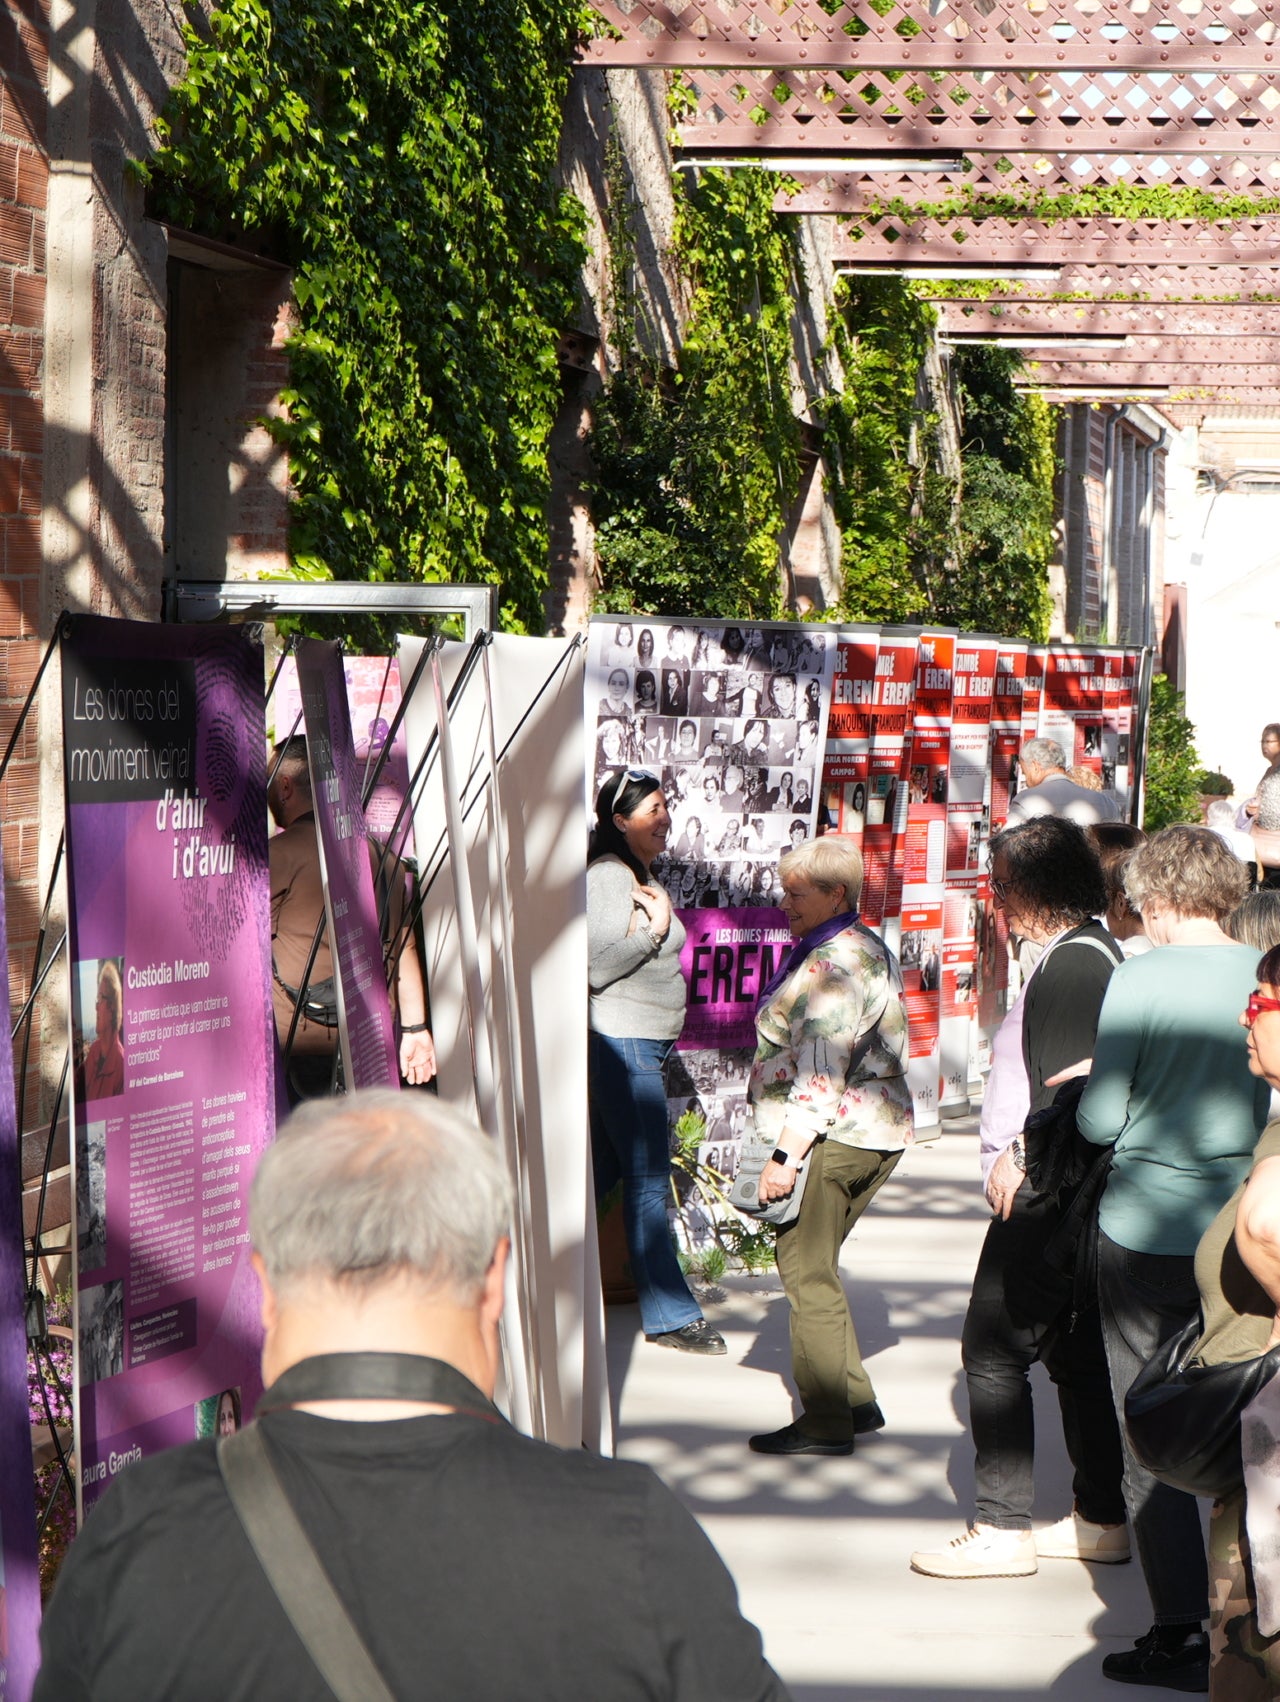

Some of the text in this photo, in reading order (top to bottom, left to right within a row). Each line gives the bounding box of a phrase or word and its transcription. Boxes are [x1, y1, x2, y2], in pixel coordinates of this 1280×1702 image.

[73, 677, 180, 721] Les dones del
[70, 736, 191, 782] moviment veïnal
[825, 754, 841, 764] ARÍA
[830, 768, 855, 776] CAMPOS
[380, 824, 402, 833] Doa
[172, 837, 179, 879] i
[715, 929, 732, 944] LES
[732, 928, 762, 943] DONES
[127, 960, 210, 990] Custòdia Moreno
[139, 1008, 161, 1026] primera
[160, 1004, 179, 1019] victòria
[179, 1004, 191, 1019] que
[190, 1001, 203, 1013] vam
[127, 1033, 138, 1046] ser
[162, 1027, 173, 1043] por
[175, 1022, 190, 1038] sortir
[189, 1020, 195, 1034] al
[195, 1020, 211, 1034] carrer
[211, 1018, 221, 1034] per
[221, 1015, 231, 1028] uns
[234, 1144, 251, 1156] seus
[235, 1230, 251, 1245] amb
[82, 1460, 107, 1488] aura
